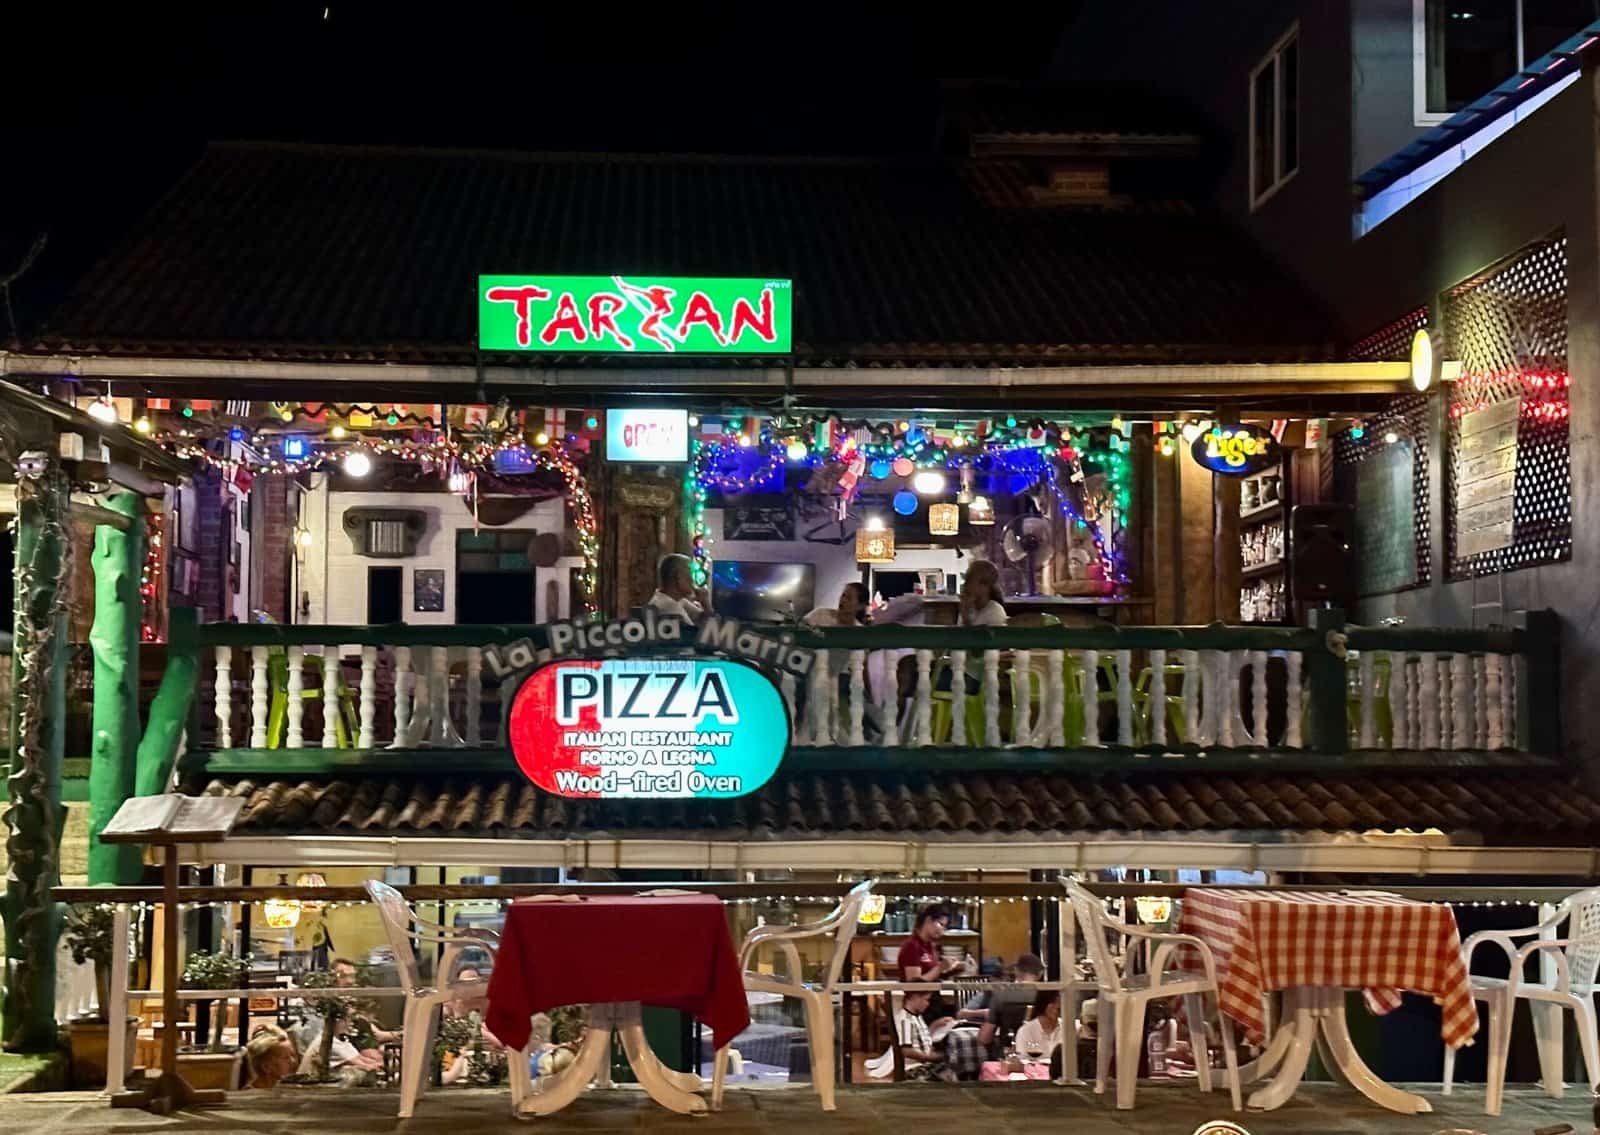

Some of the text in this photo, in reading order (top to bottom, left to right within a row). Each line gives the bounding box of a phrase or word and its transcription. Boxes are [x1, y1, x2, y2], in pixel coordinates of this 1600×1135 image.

[1203, 431, 1271, 467] Tiger
[484, 614, 814, 677] La Piccola Maria
[559, 670, 737, 722] PIZZA
[563, 731, 733, 746] ITALIAN RESTAURANT
[580, 751, 715, 766] FORNO A LEGNA
[556, 771, 742, 793] Wood-fired Oven
